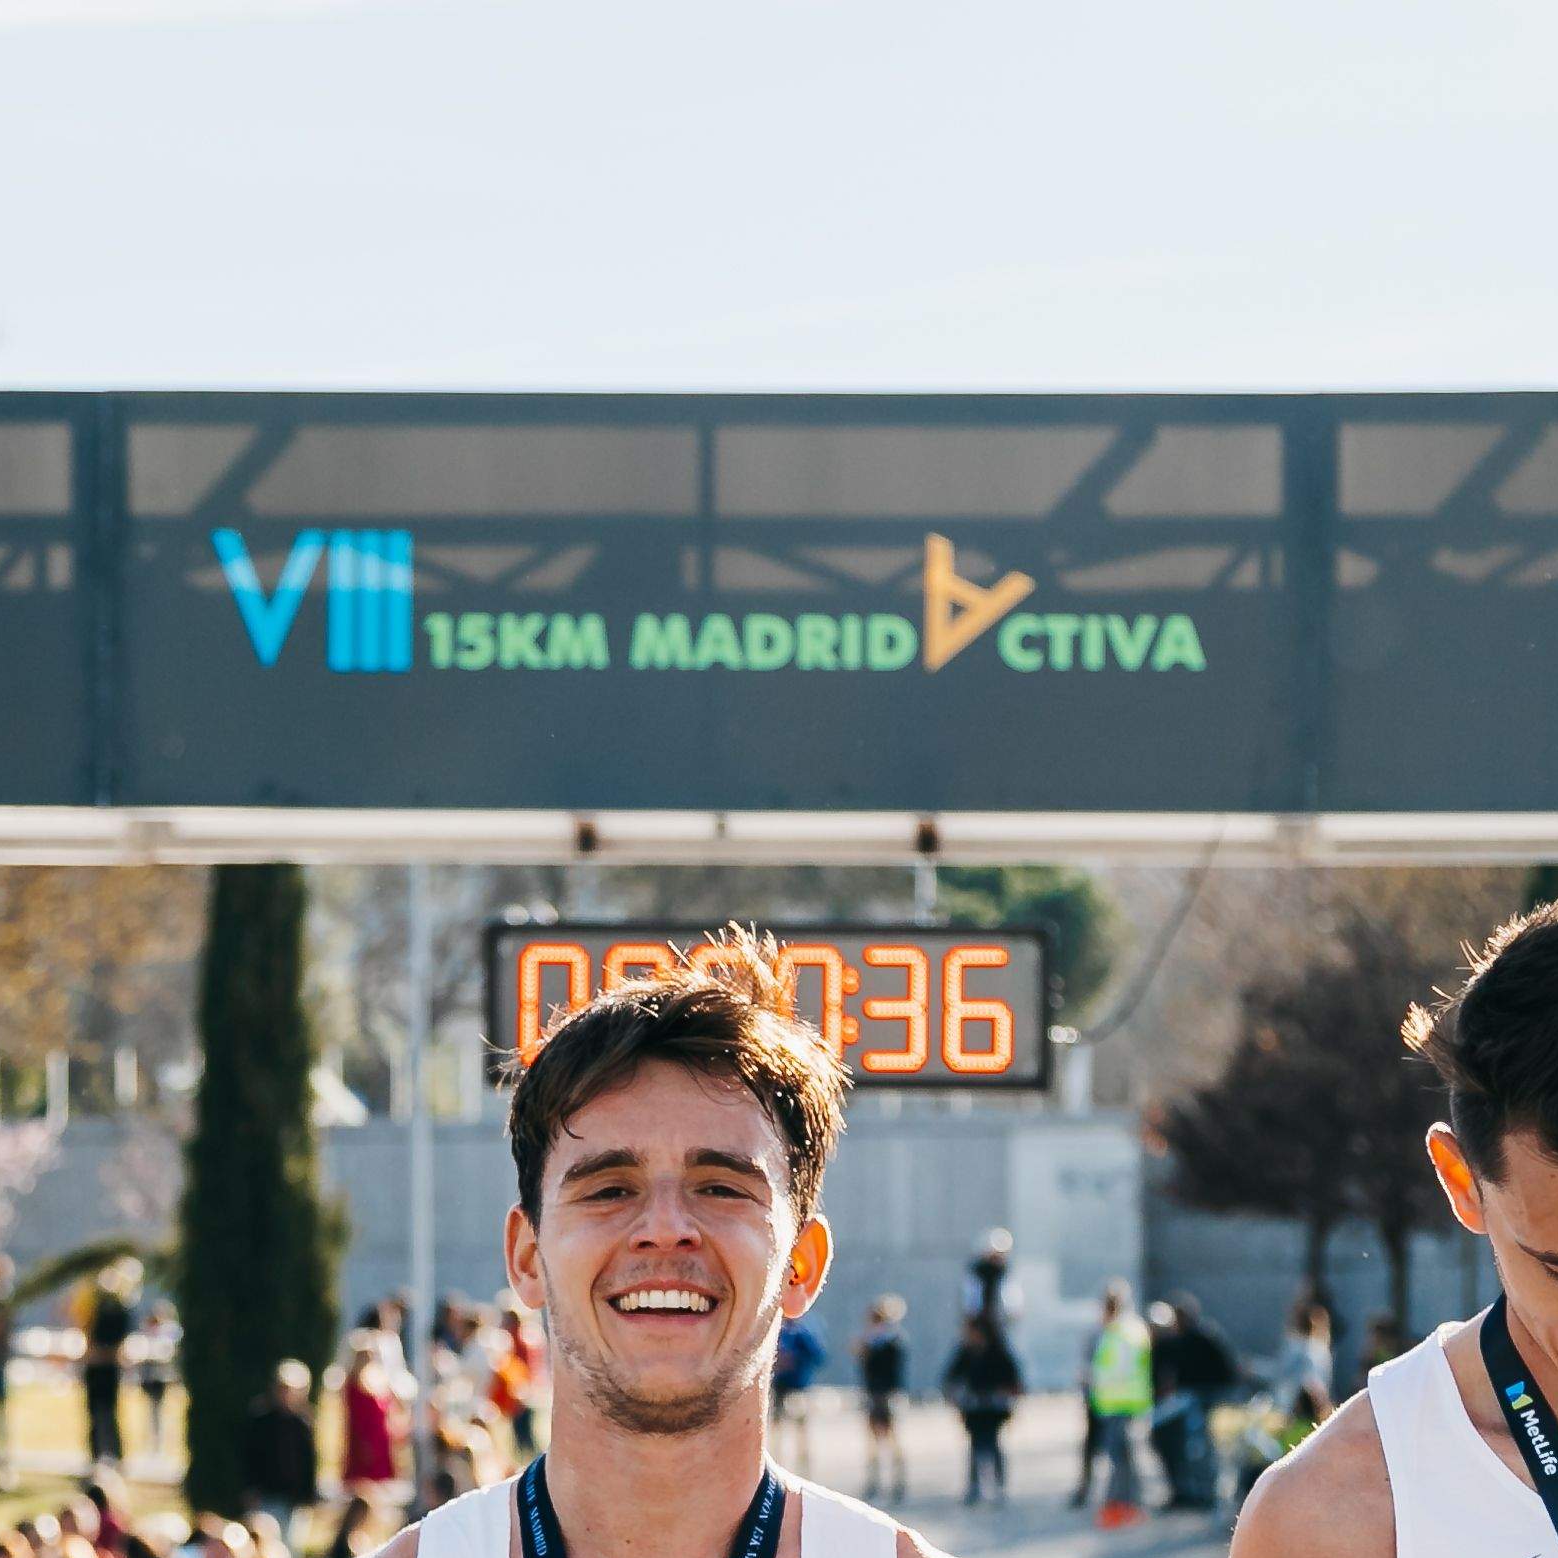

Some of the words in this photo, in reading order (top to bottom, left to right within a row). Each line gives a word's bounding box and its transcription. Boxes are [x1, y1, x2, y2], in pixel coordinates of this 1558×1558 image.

[210, 526, 416, 674] VIII
[424, 611, 610, 670] 15KM
[629, 612, 918, 671] MADRID
[1519, 1408, 1558, 1477] MetLife
[529, 1505, 548, 1557] MADRID
[748, 1525, 764, 1549] 15K
